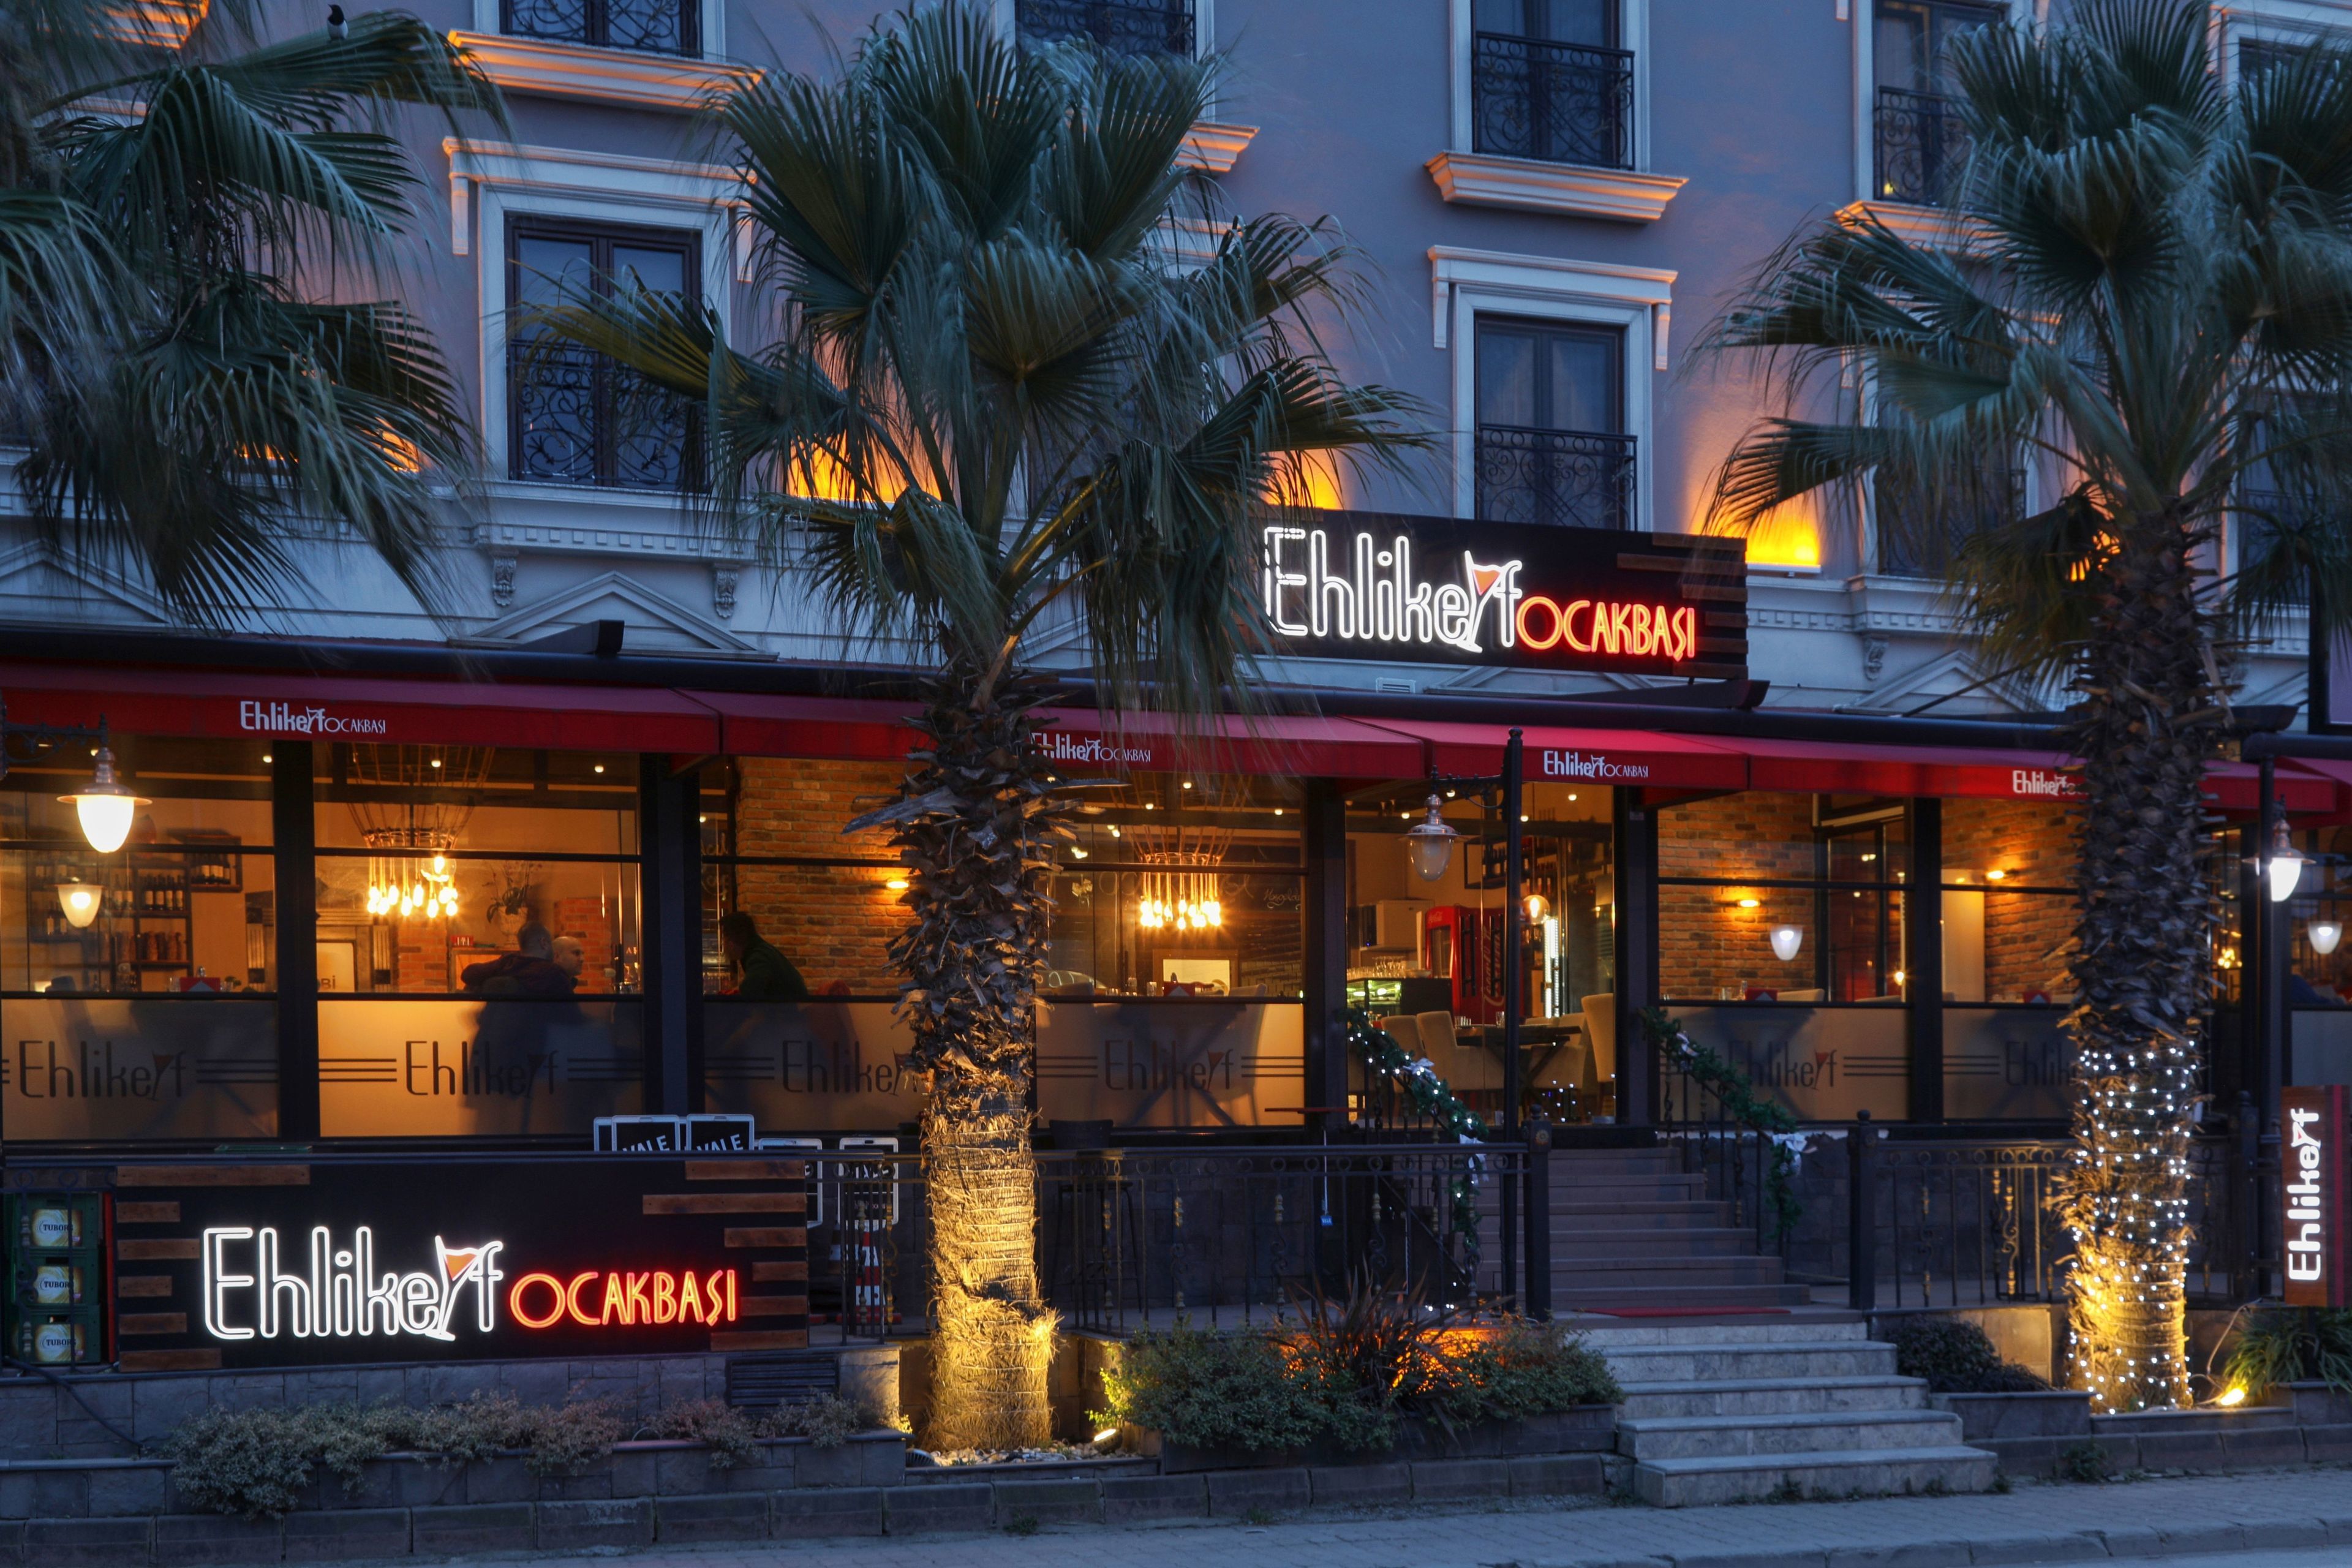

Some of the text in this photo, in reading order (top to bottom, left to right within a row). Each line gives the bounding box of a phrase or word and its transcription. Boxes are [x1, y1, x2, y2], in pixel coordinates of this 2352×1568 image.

[1515, 596, 1695, 662] OCAKBAŞI
[324, 717, 386, 734] OCAKBAŞI
[42, 1223, 74, 1232] TUBOR
[43, 1280, 74, 1289] TUBOR
[509, 1268, 737, 1327] OCAKBAŞI
[46, 1338, 77, 1347] TUBOR
